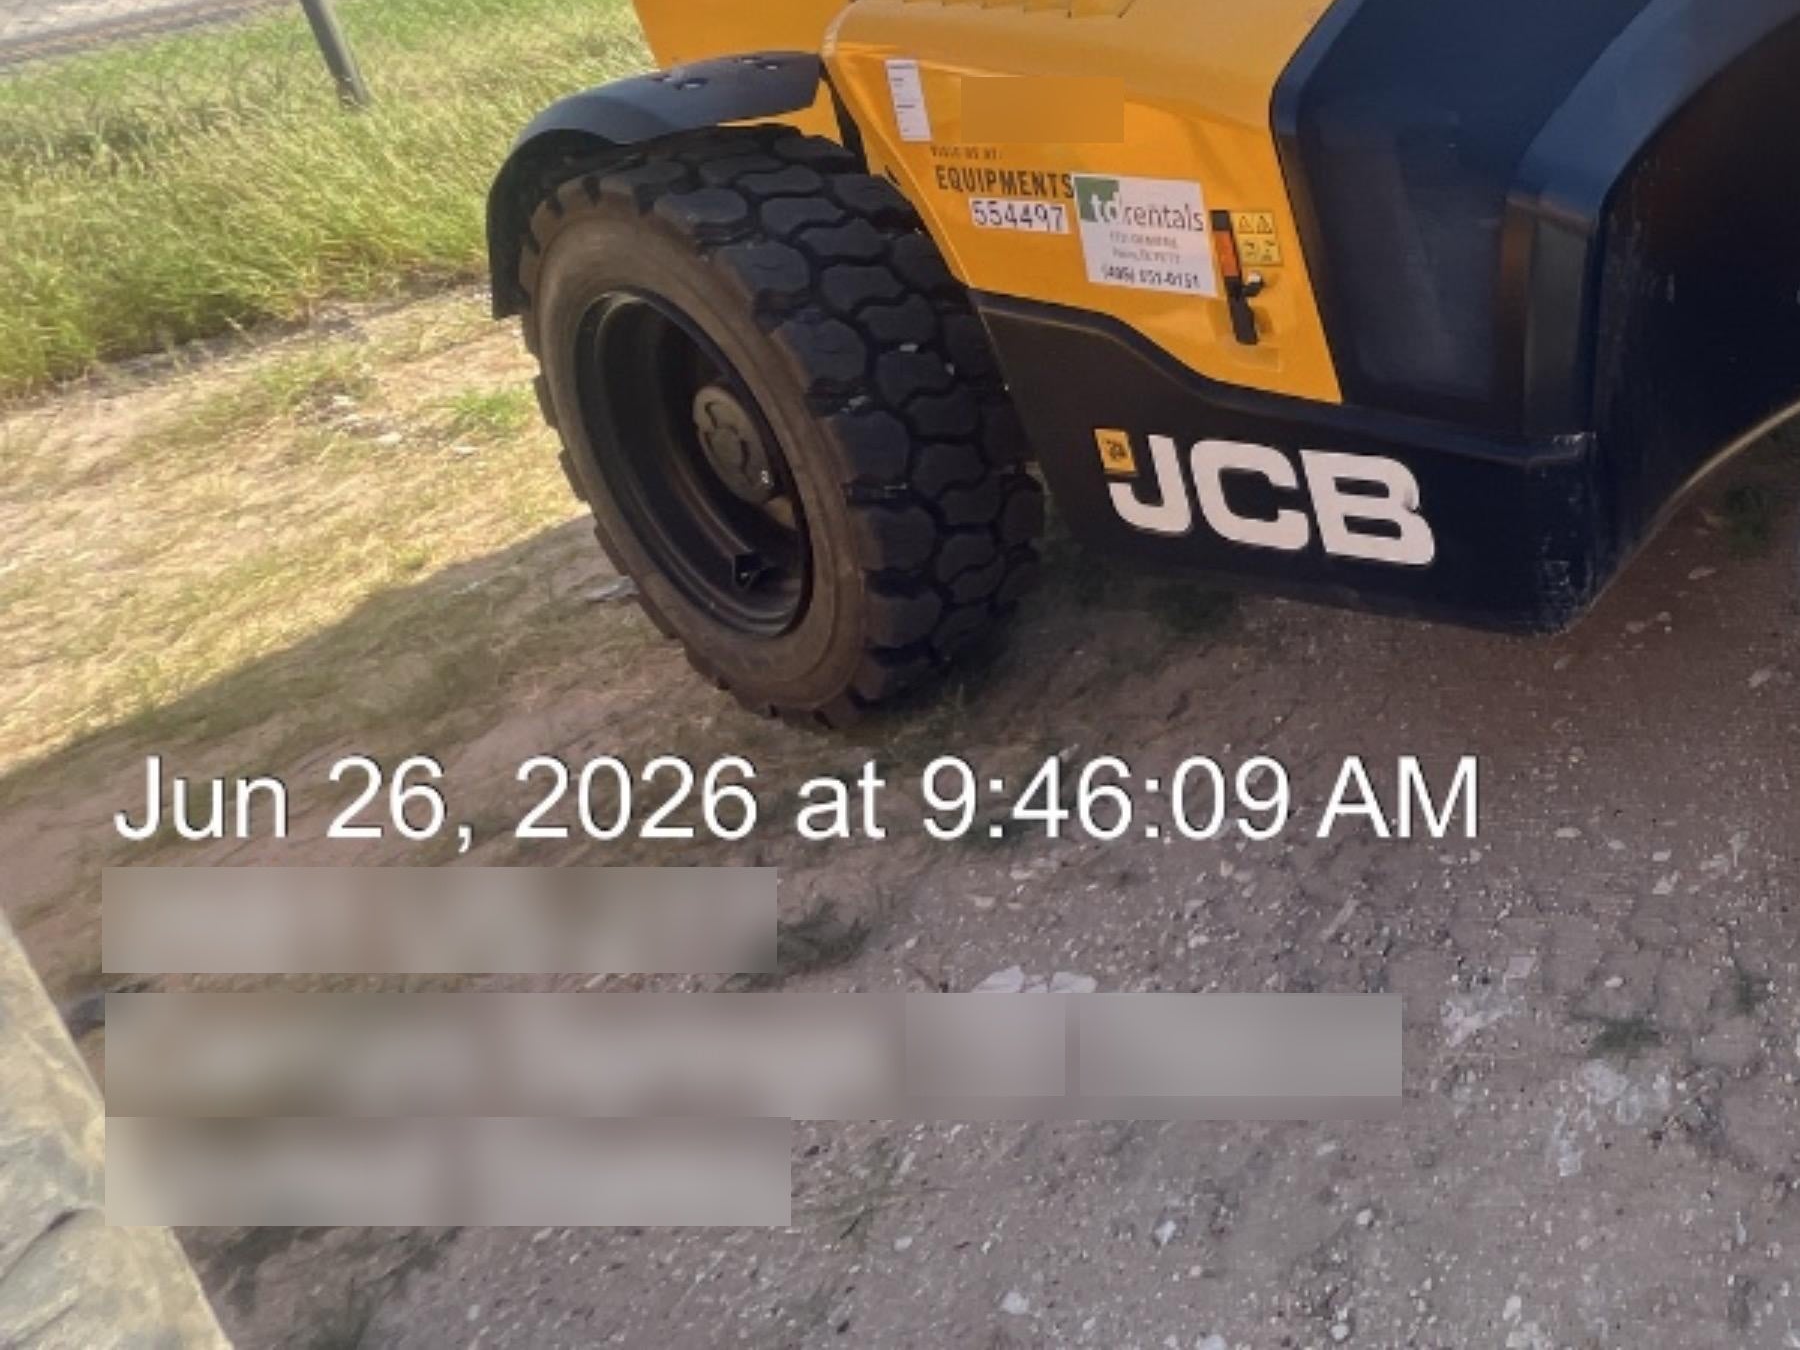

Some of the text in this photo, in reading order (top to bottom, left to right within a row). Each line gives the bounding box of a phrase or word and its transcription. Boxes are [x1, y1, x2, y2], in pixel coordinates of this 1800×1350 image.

[935, 164, 1075, 199] EQUIPMENTS
[971, 199, 1064, 233] 554497
[1108, 434, 1436, 567] JCB
